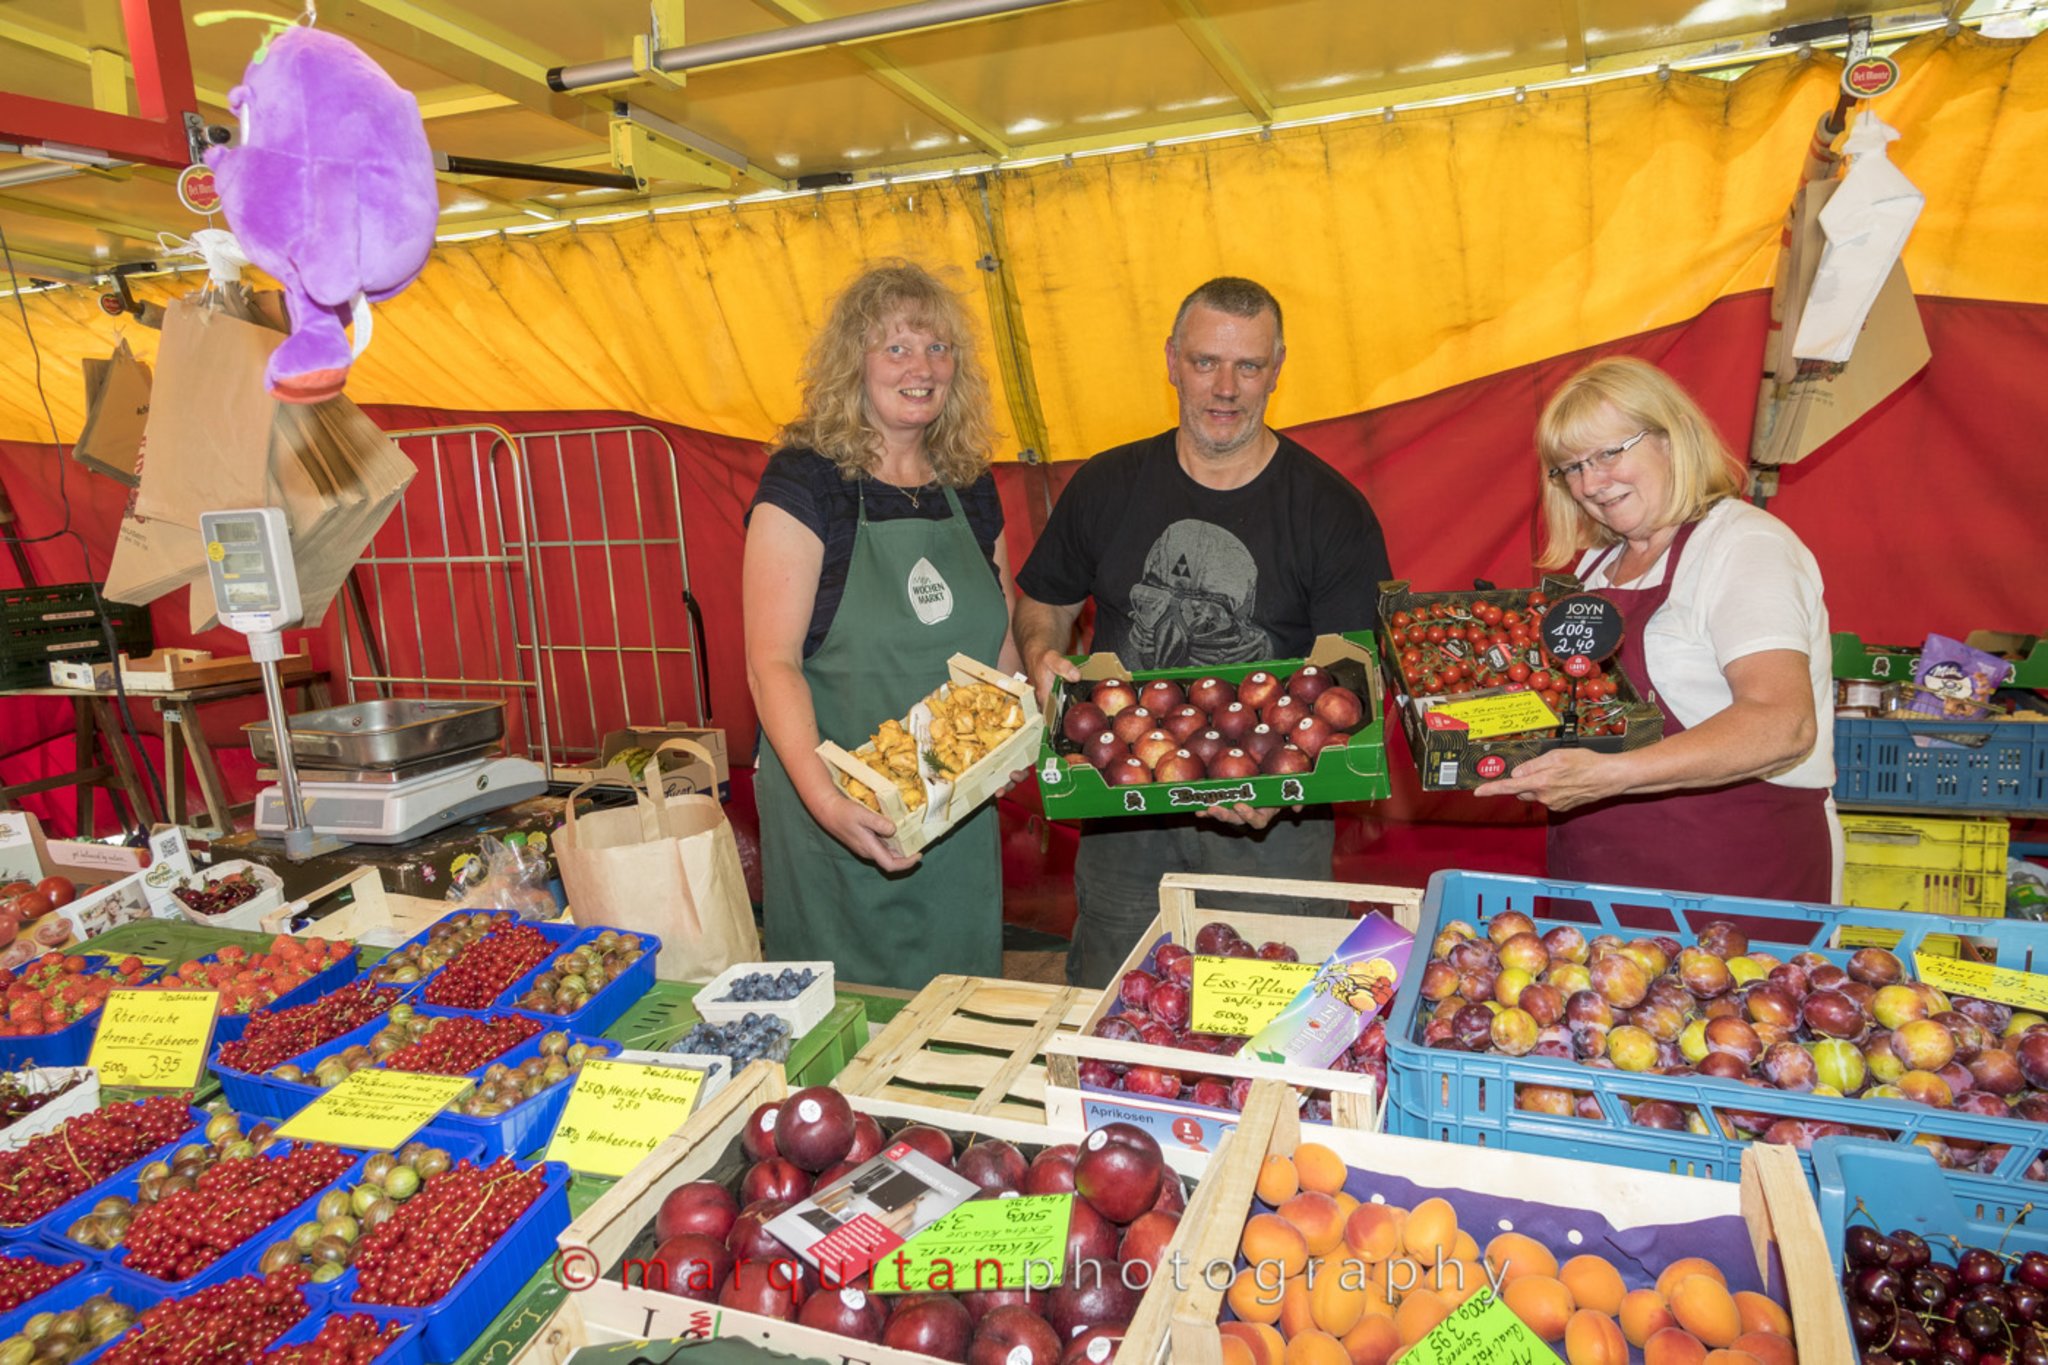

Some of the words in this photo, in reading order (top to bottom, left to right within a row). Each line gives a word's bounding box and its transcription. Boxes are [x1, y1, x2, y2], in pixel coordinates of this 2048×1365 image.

[913, 583, 945, 595] WOCHEN
[918, 592, 945, 604] MARKT
[1566, 603, 1604, 616] JOYN
[1551, 623, 1593, 639] 100g
[1553, 637, 1595, 655] 2,40
[1213, 1010, 1249, 1025] 500g
[100, 1060, 128, 1079] 500g
[576, 1081, 606, 1099] 250g
[1091, 1105, 1154, 1124] Aprikosen
[586, 1130, 643, 1149] Himbeeren
[1006, 1208, 1052, 1224] 500g
[920, 1238, 1052, 1257] Nektarinen
